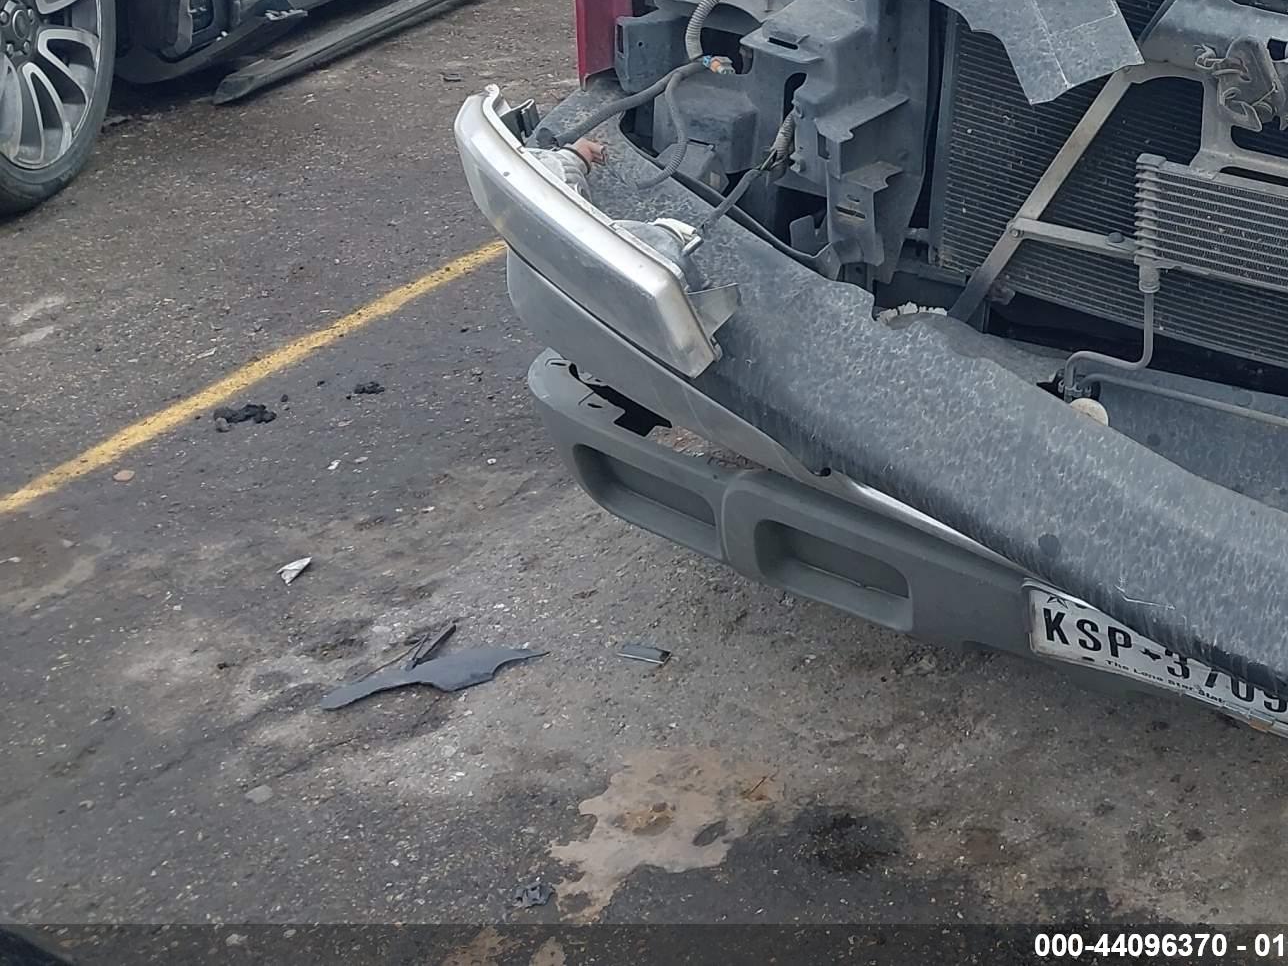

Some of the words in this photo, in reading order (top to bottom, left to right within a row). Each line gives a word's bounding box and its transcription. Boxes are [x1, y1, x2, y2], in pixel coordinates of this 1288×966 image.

[1105, 659, 1129, 671] The
[1133, 668, 1164, 682] Lone
[1198, 688, 1226, 703] Stat
